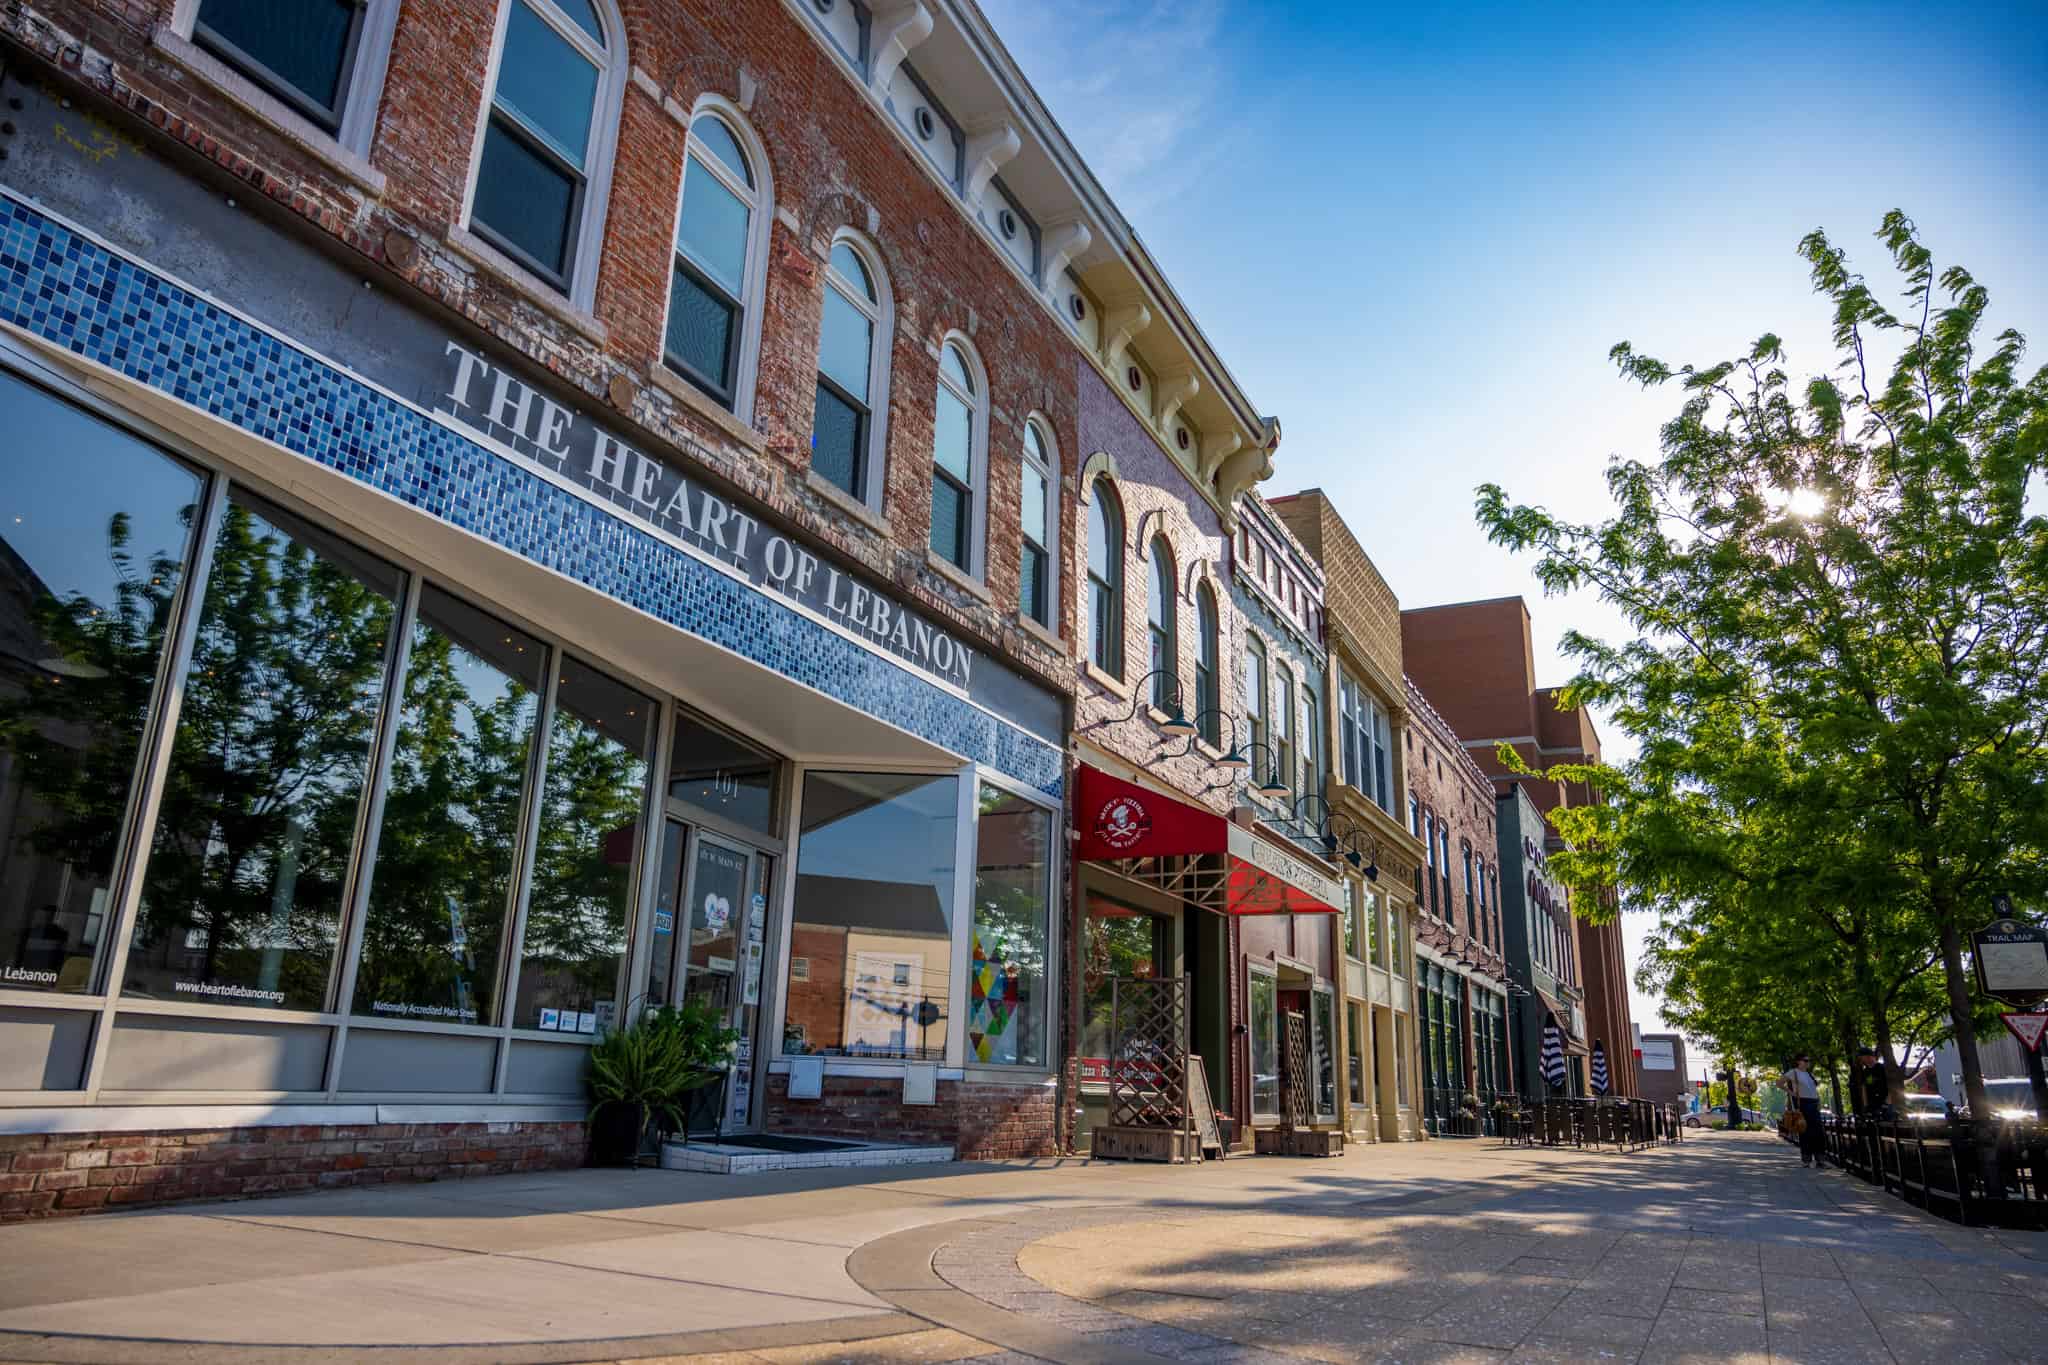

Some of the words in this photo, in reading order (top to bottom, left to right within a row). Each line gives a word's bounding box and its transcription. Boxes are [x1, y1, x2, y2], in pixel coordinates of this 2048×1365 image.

[445, 341, 574, 460] THE
[586, 428, 758, 560] HEART
[764, 535, 818, 593] OF
[826, 567, 973, 683] LEBANON
[4, 966, 57, 983] Lebanon
[372, 1000, 408, 1015] Nationally
[444, 1005, 458, 1016] Main
